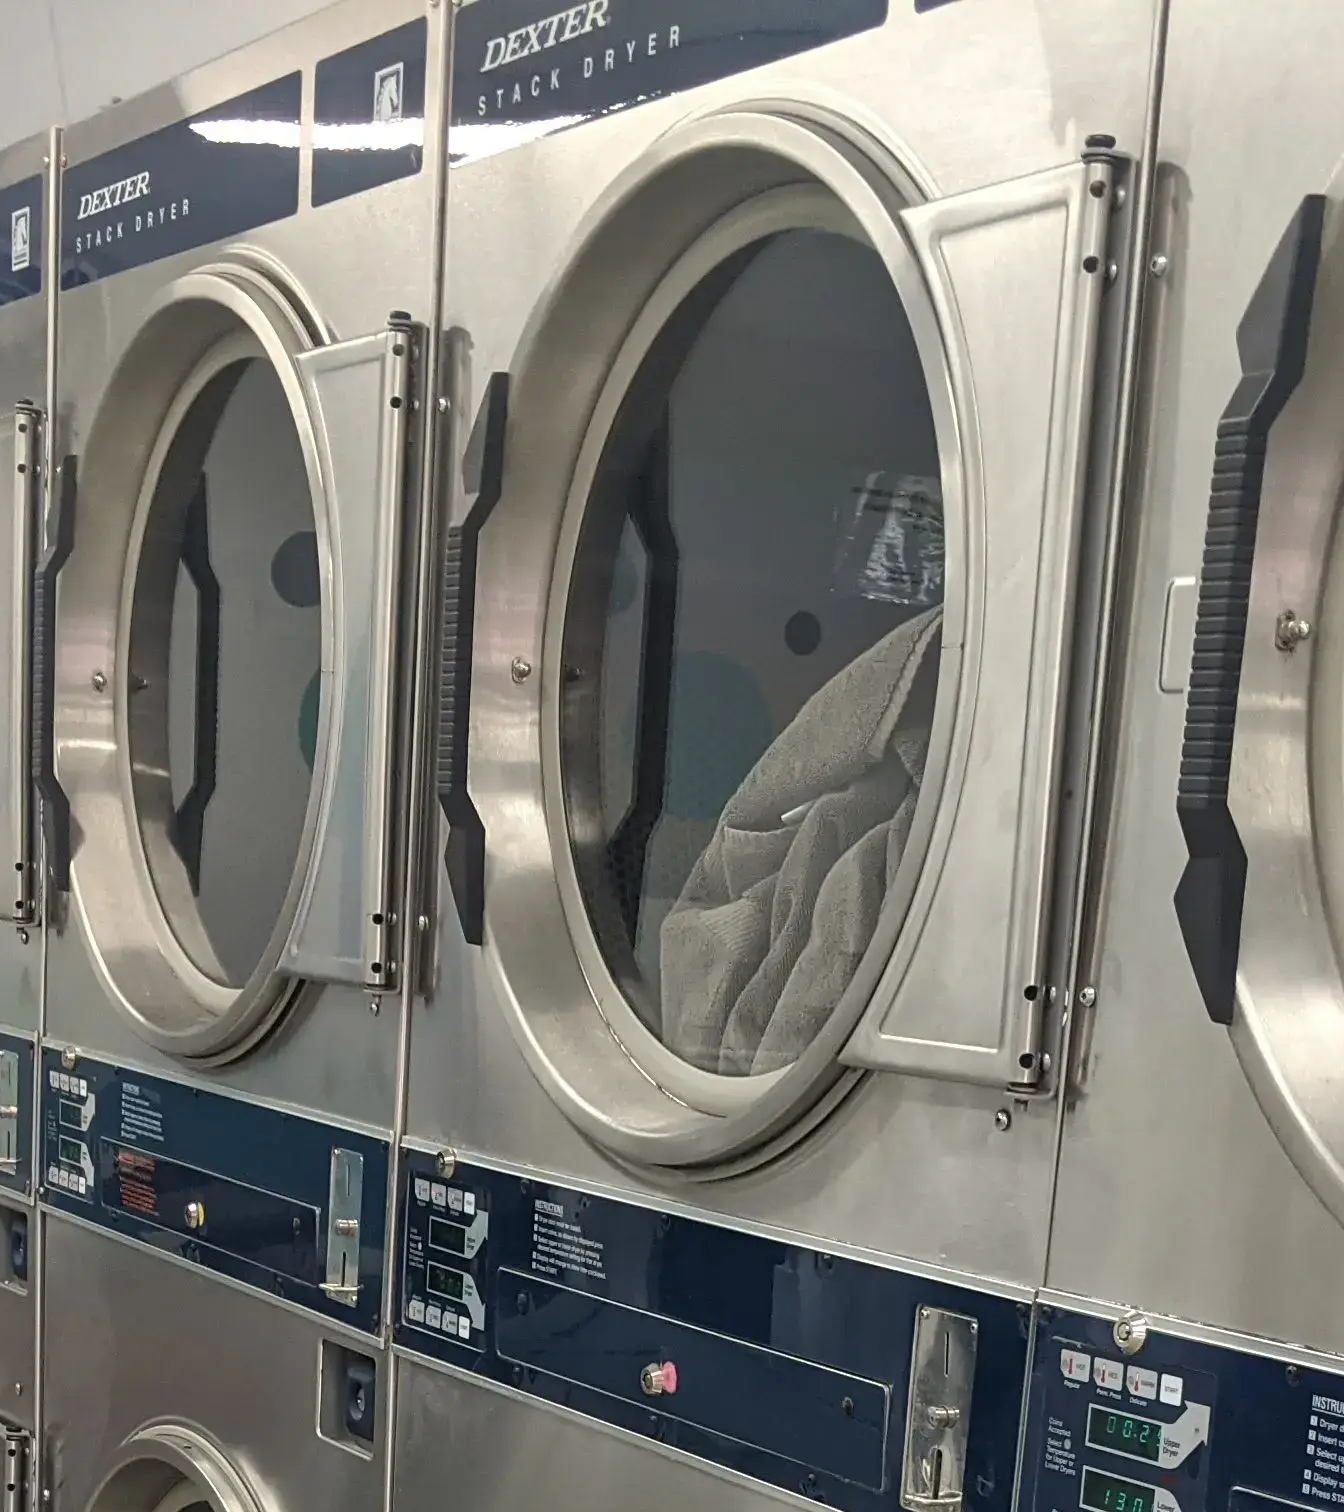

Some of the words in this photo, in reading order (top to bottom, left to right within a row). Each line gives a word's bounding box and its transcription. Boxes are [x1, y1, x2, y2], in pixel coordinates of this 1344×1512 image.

[479, 0, 608, 73] DEXTER
[478, 68, 560, 116] STACK
[583, 25, 680, 78] DRYER
[77, 170, 150, 221] DEXTER
[76, 222, 123, 254] STACK
[135, 198, 190, 232] DRYER
[1319, 1418, 1338, 1431] Dryer
[1164, 1437, 1181, 1449] Upper
[1162, 1446, 1179, 1458] Dryer
[1316, 1447, 1337, 1461] Select
[1315, 1459, 1340, 1473] desired
[1313, 1472, 1338, 1489] Display
[1311, 1486, 1331, 1500] Press
[1157, 1501, 1175, 1512] Lower
